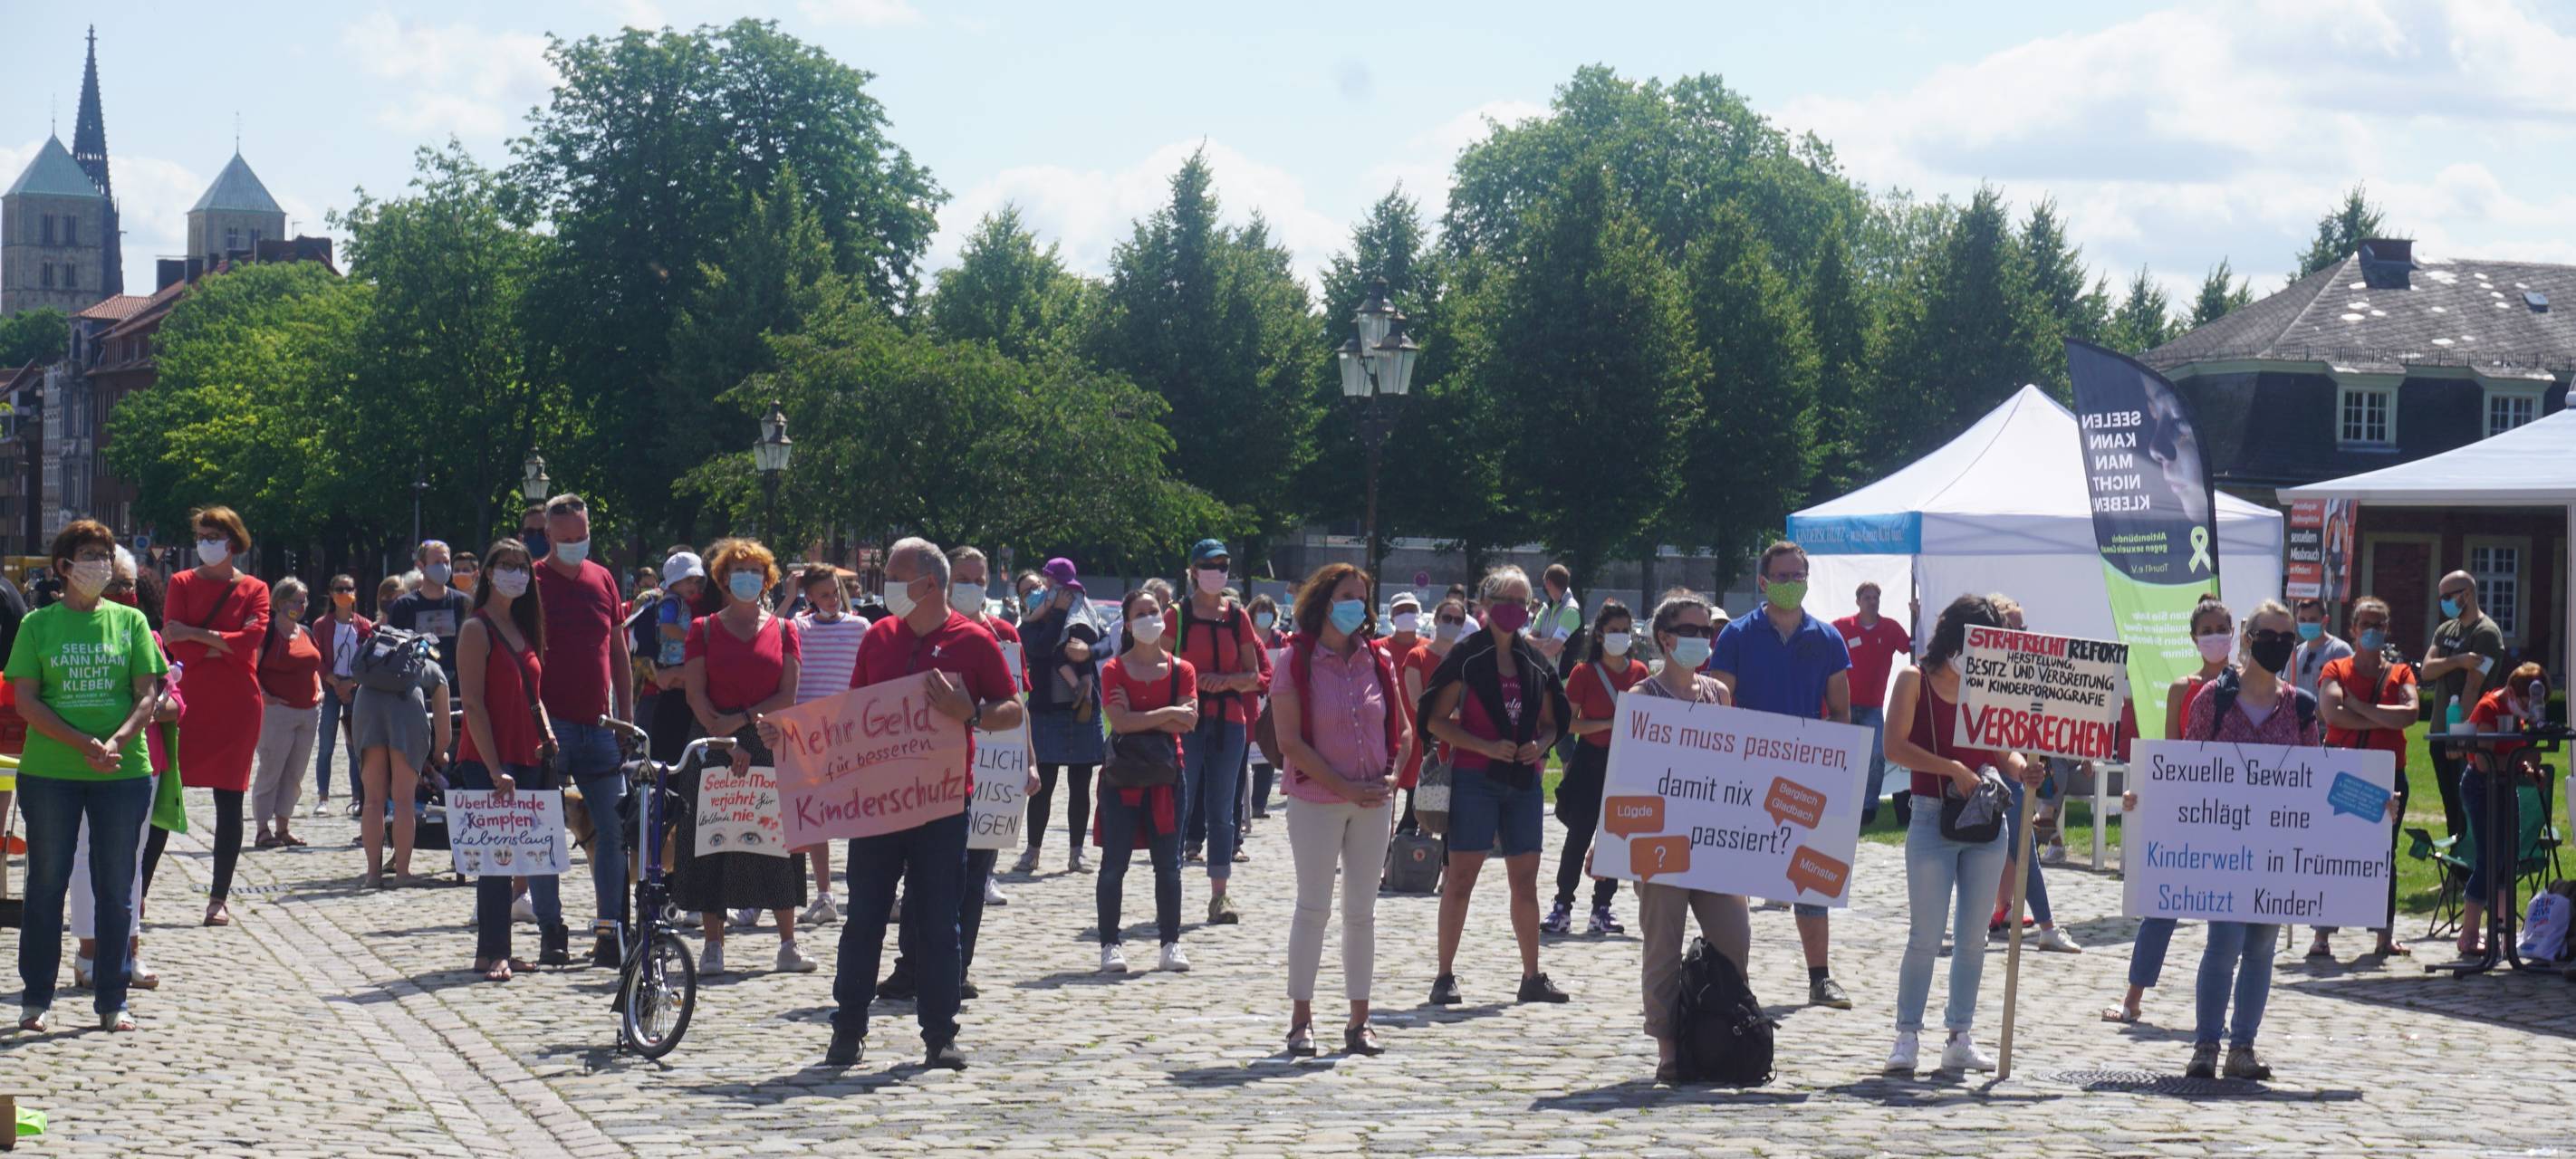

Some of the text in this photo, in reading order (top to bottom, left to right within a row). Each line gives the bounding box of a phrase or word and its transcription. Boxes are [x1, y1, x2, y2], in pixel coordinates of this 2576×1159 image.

[50, 653, 126, 667] KANN MAN
[62, 642, 114, 654] SEELEN
[2006, 651, 2076, 672] HERSTELLUNG,
[68, 666, 110, 679] NICHT
[1966, 656, 2115, 692] BESITZ UND VERBREITUNG
[1965, 675, 2105, 707] VON KINDERPORNOGRAFIE
[782, 695, 938, 763] Mehr Geld
[1630, 709, 1849, 771] Was muss passieren,
[1961, 702, 2122, 761] VERBRECHEN!
[825, 737, 937, 782] für besseren
[2151, 753, 2313, 789] Sexuelle Gewalt
[710, 790, 777, 812] verjährt für
[794, 767, 966, 832] Kinderschutz
[1657, 766, 1754, 808] damit nix
[1778, 781, 1819, 807] Bergisch
[464, 810, 533, 833] Kämpfen
[732, 808, 755, 823] nie
[1616, 803, 1654, 819] Lügde
[1771, 798, 1815, 823] Gladbach
[2177, 797, 2311, 831] schlägt eine
[1690, 825, 1793, 856] passiert?
[1653, 845, 1667, 869] ?
[1798, 856, 1839, 884] Münster
[2147, 840, 2391, 878] Kinderwelt in Trümmer!
[2158, 883, 2324, 917] Schützt Kinder!
